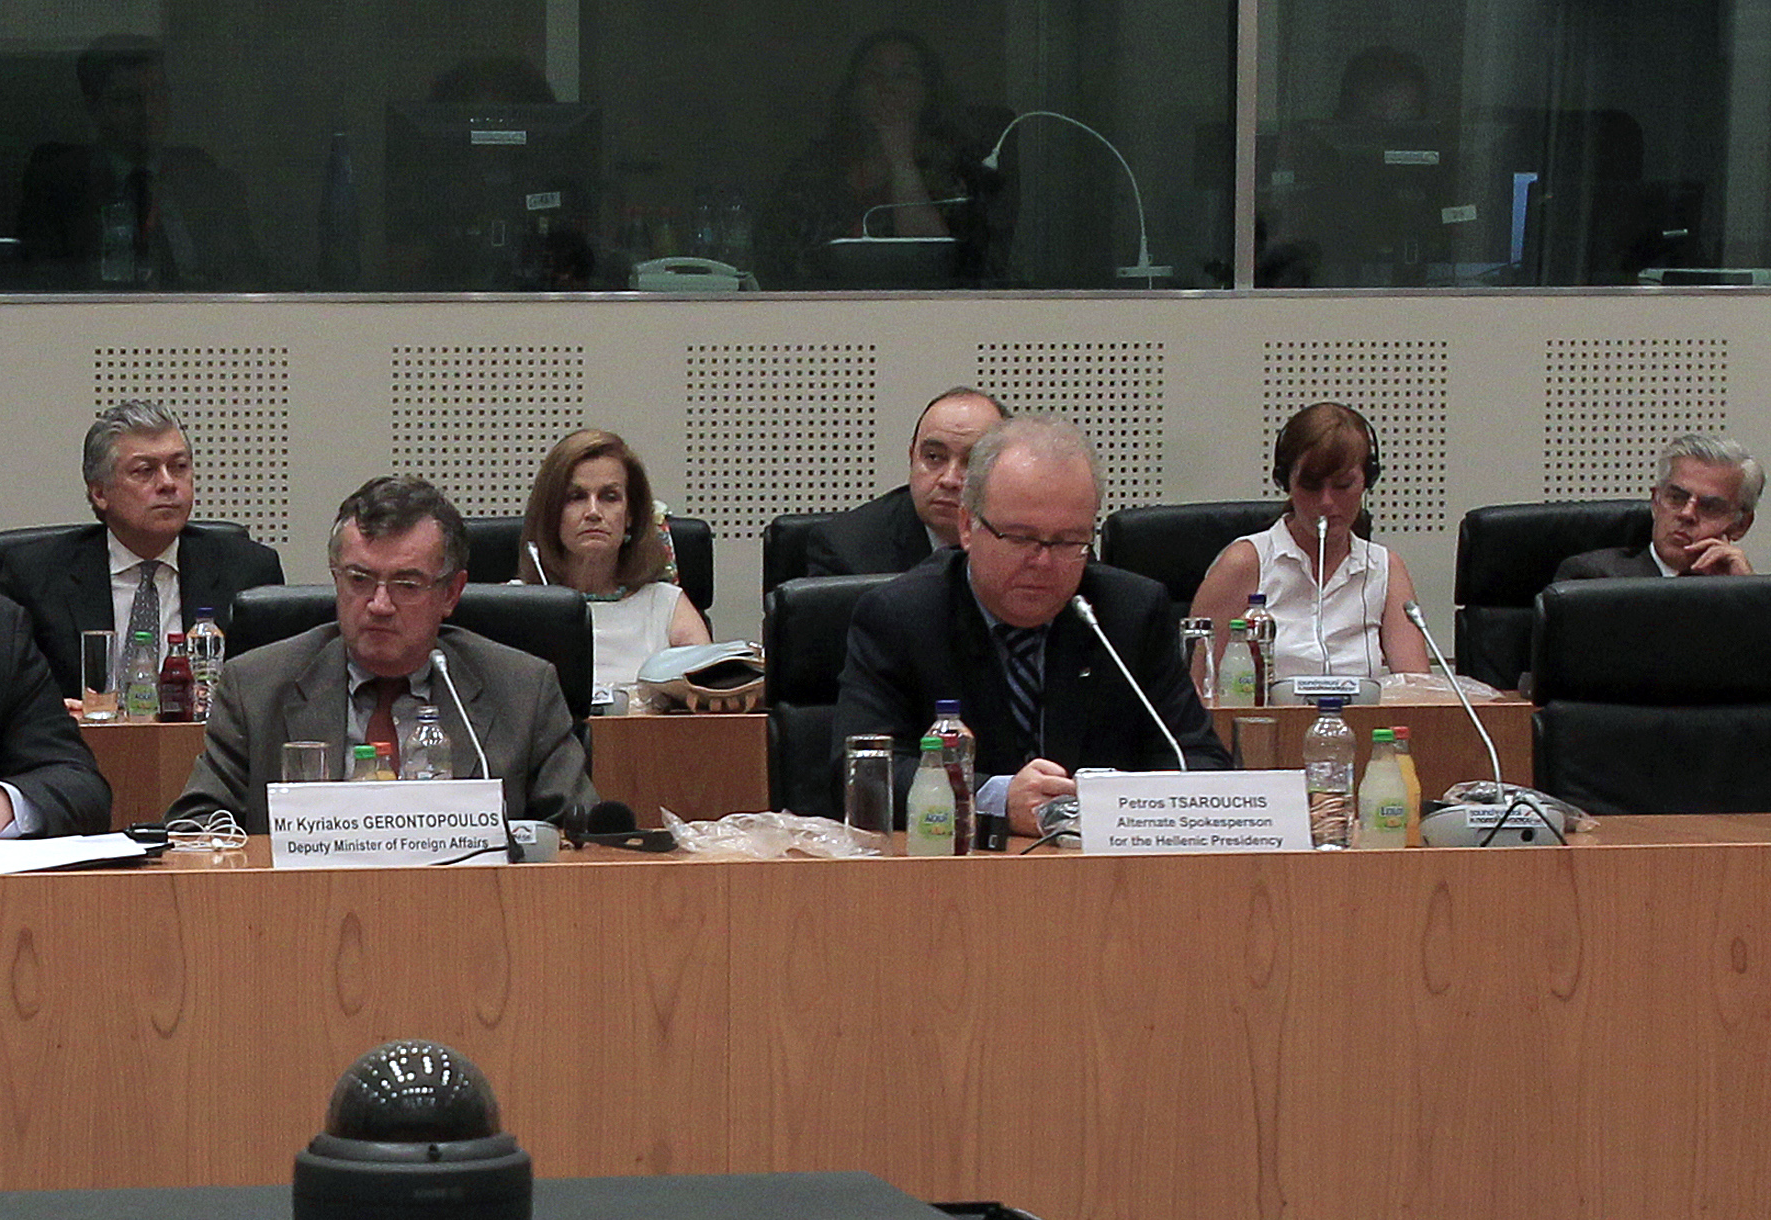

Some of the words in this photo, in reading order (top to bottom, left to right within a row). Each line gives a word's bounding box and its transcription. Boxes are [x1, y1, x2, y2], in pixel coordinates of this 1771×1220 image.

[1119, 797, 1165, 808] Petros
[1169, 796, 1268, 808] TSAROUCHIS
[274, 818, 292, 832] Mr
[297, 816, 359, 834] Kyriakos
[363, 813, 499, 829] GERONTOPOULOS
[1117, 817, 1175, 828] Alternate
[1180, 816, 1272, 829] Spokesperson
[288, 840, 330, 855] Deputy
[334, 838, 382, 852] Minister
[385, 838, 398, 850] of
[401, 837, 446, 853] Foreign
[449, 837, 489, 849] Affairs
[1109, 835, 1127, 846] for
[1131, 835, 1152, 846] the
[1156, 835, 1208, 846] Hellenic
[1211, 835, 1283, 848] Presidency
